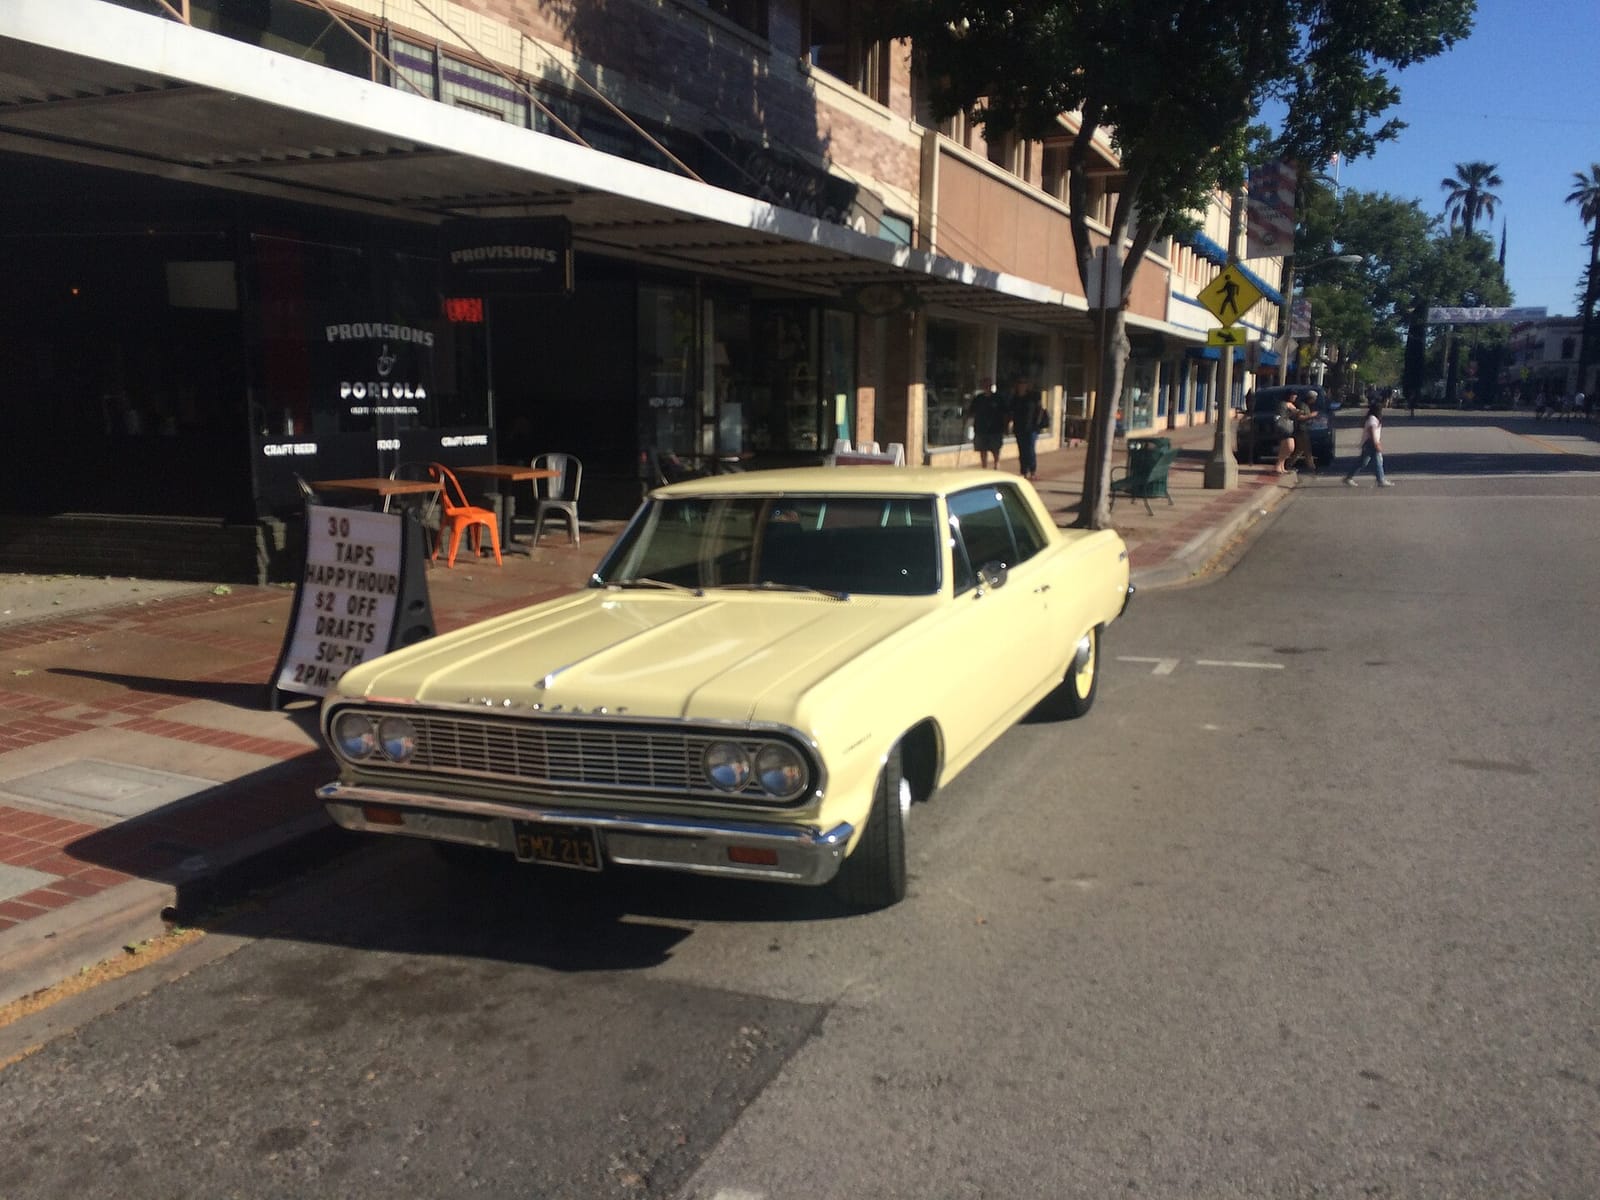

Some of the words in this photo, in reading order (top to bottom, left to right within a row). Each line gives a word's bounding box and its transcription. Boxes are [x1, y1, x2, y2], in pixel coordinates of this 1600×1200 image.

[451, 246, 557, 263] PROVISIONS
[326, 323, 434, 347] PROVISIONS
[340, 382, 427, 400] PORTOLA
[263, 444, 293, 456] CRAFT
[328, 516, 350, 538] 30
[336, 542, 375, 566] TAPS
[315, 592, 336, 612] $2
[347, 595, 376, 618] OFF
[315, 616, 375, 643] DRAFTS
[315, 642, 366, 665] SU-TH
